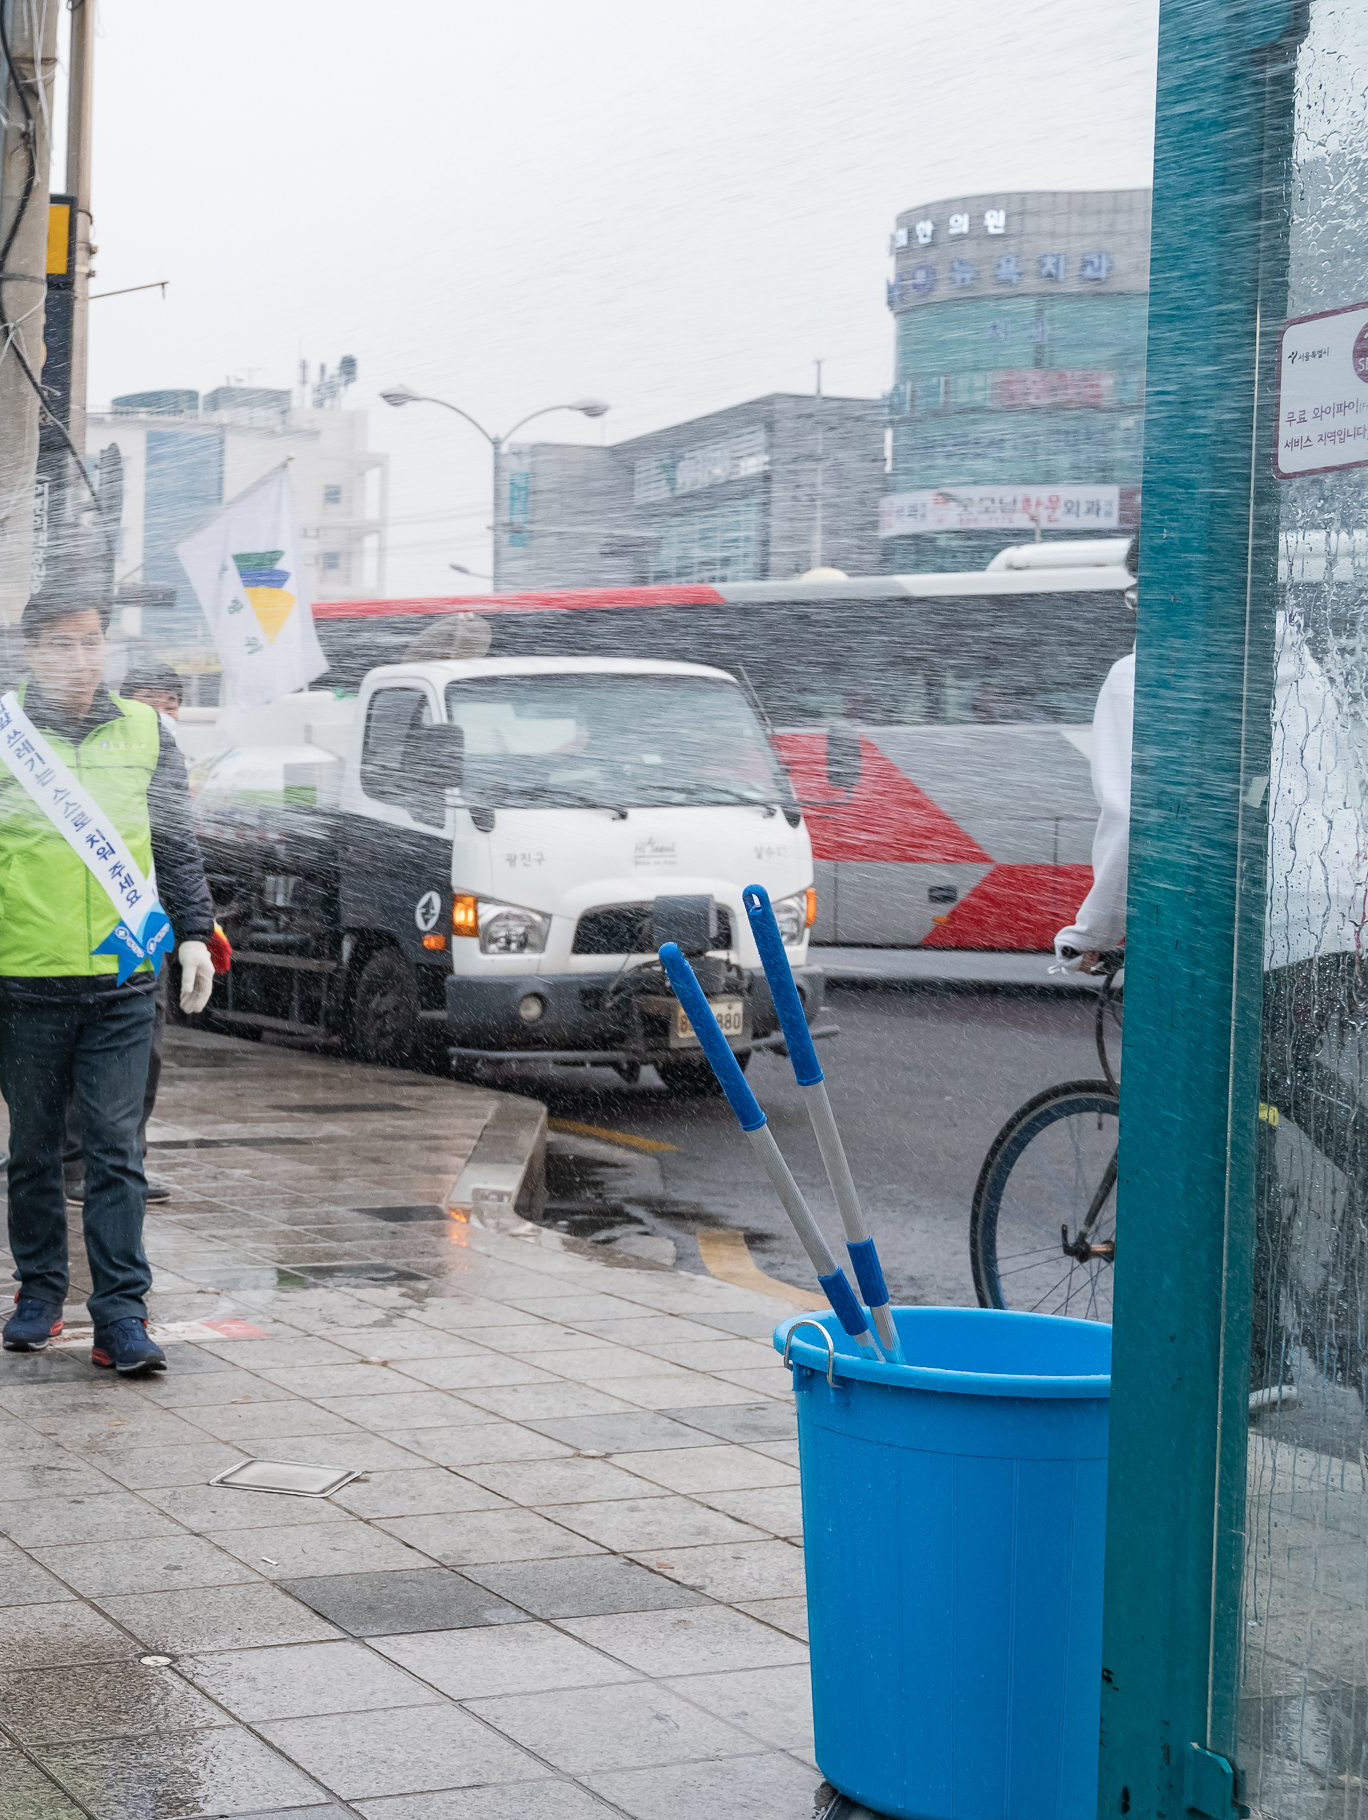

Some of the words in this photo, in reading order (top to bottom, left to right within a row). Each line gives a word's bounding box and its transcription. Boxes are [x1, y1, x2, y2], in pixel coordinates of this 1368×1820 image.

[1297, 347, 1330, 362] 서울특별시
[1284, 410, 1308, 427] 무료
[1284, 435, 1314, 452] 서비스
[6, 729, 56, 787] 쓰레기는
[85, 827, 116, 861] 치워
[108, 861, 143, 909] 주세요
[505, 851, 546, 868] 광진구
